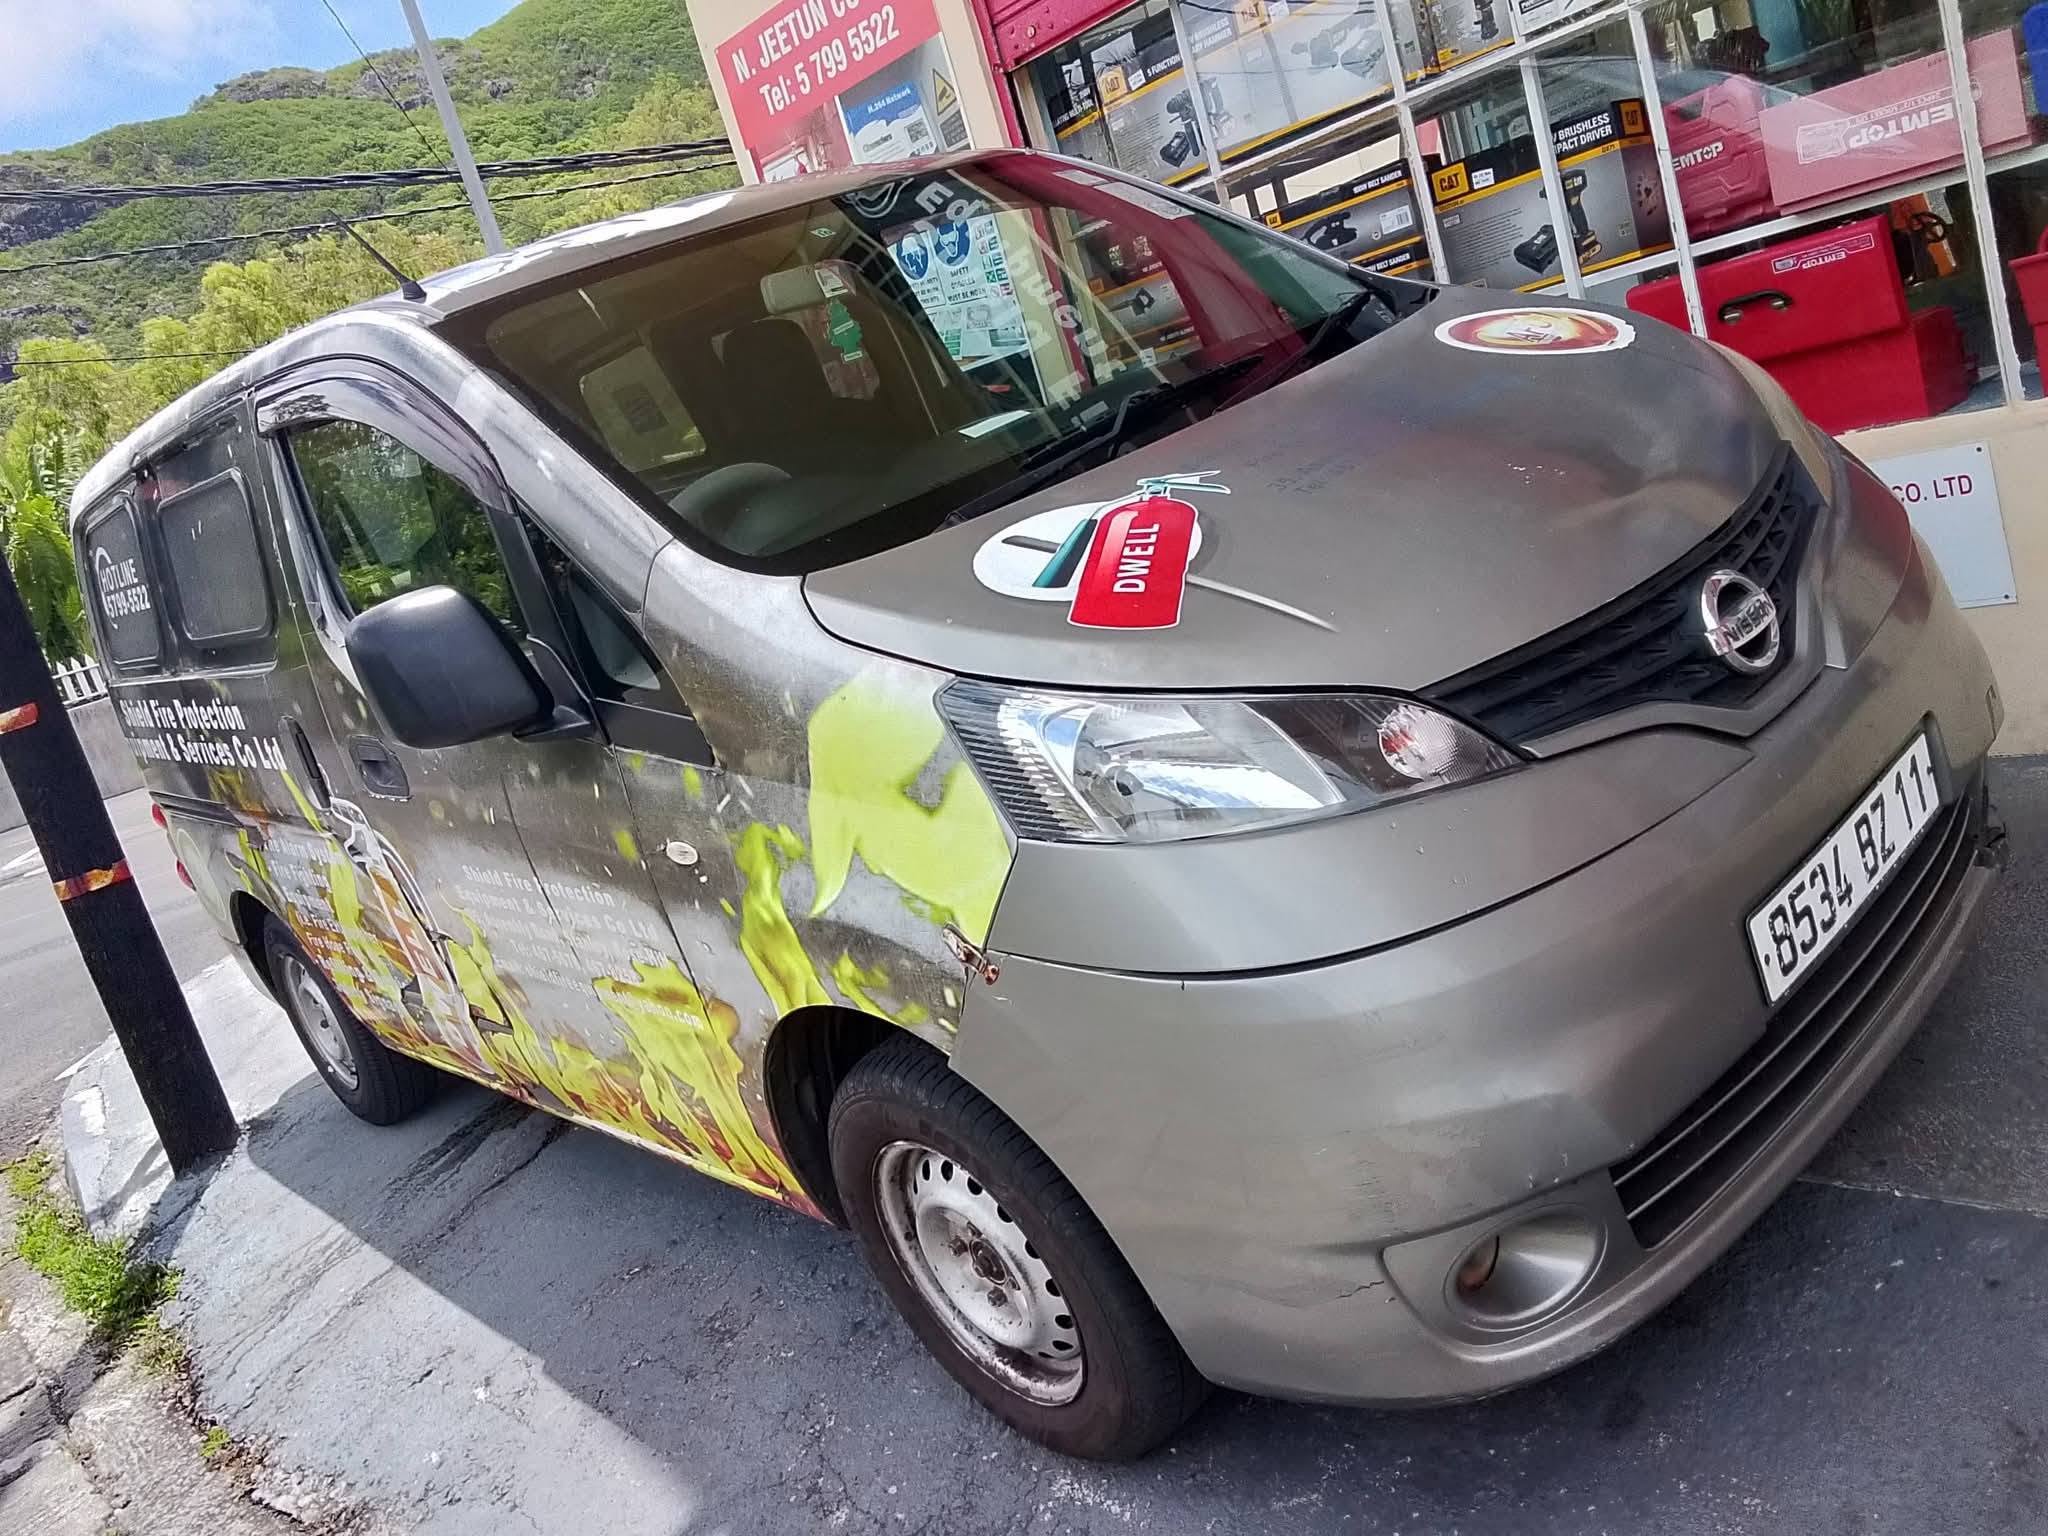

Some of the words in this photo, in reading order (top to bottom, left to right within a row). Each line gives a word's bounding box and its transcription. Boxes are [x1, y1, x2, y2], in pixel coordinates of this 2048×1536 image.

[731, 47, 757, 83] N.
[758, 0, 829, 69] JEETUN
[758, 74, 797, 116] Tel:
[793, 61, 812, 95] 5
[808, 37, 849, 86] 799
[846, 4, 900, 62] 5522
[1557, 112, 1611, 141] BRUSHLESS
[1579, 124, 1613, 146] DRIVER
[1848, 101, 1956, 150] EMTOP
[1671, 140, 1724, 172] EMTOP
[1439, 171, 1460, 193] CAT
[1932, 474, 1974, 499] LTD
[100, 558, 139, 593] HOTLINE
[1111, 522, 1161, 594] DWELL
[1723, 598, 1770, 648] NISSAN
[119, 698, 155, 728] Shield
[150, 698, 177, 729] Fire
[173, 697, 246, 731] Protection
[166, 732, 182, 762] &
[177, 732, 236, 767] Services
[231, 735, 257, 769] Co
[252, 736, 288, 770] Ltd
[1768, 844, 1853, 978] 8534
[1855, 792, 1896, 882] BZ
[1894, 752, 1930, 830] 11
[461, 864, 504, 888] Shield
[502, 871, 533, 893] Fire
[533, 875, 616, 908] Protection
